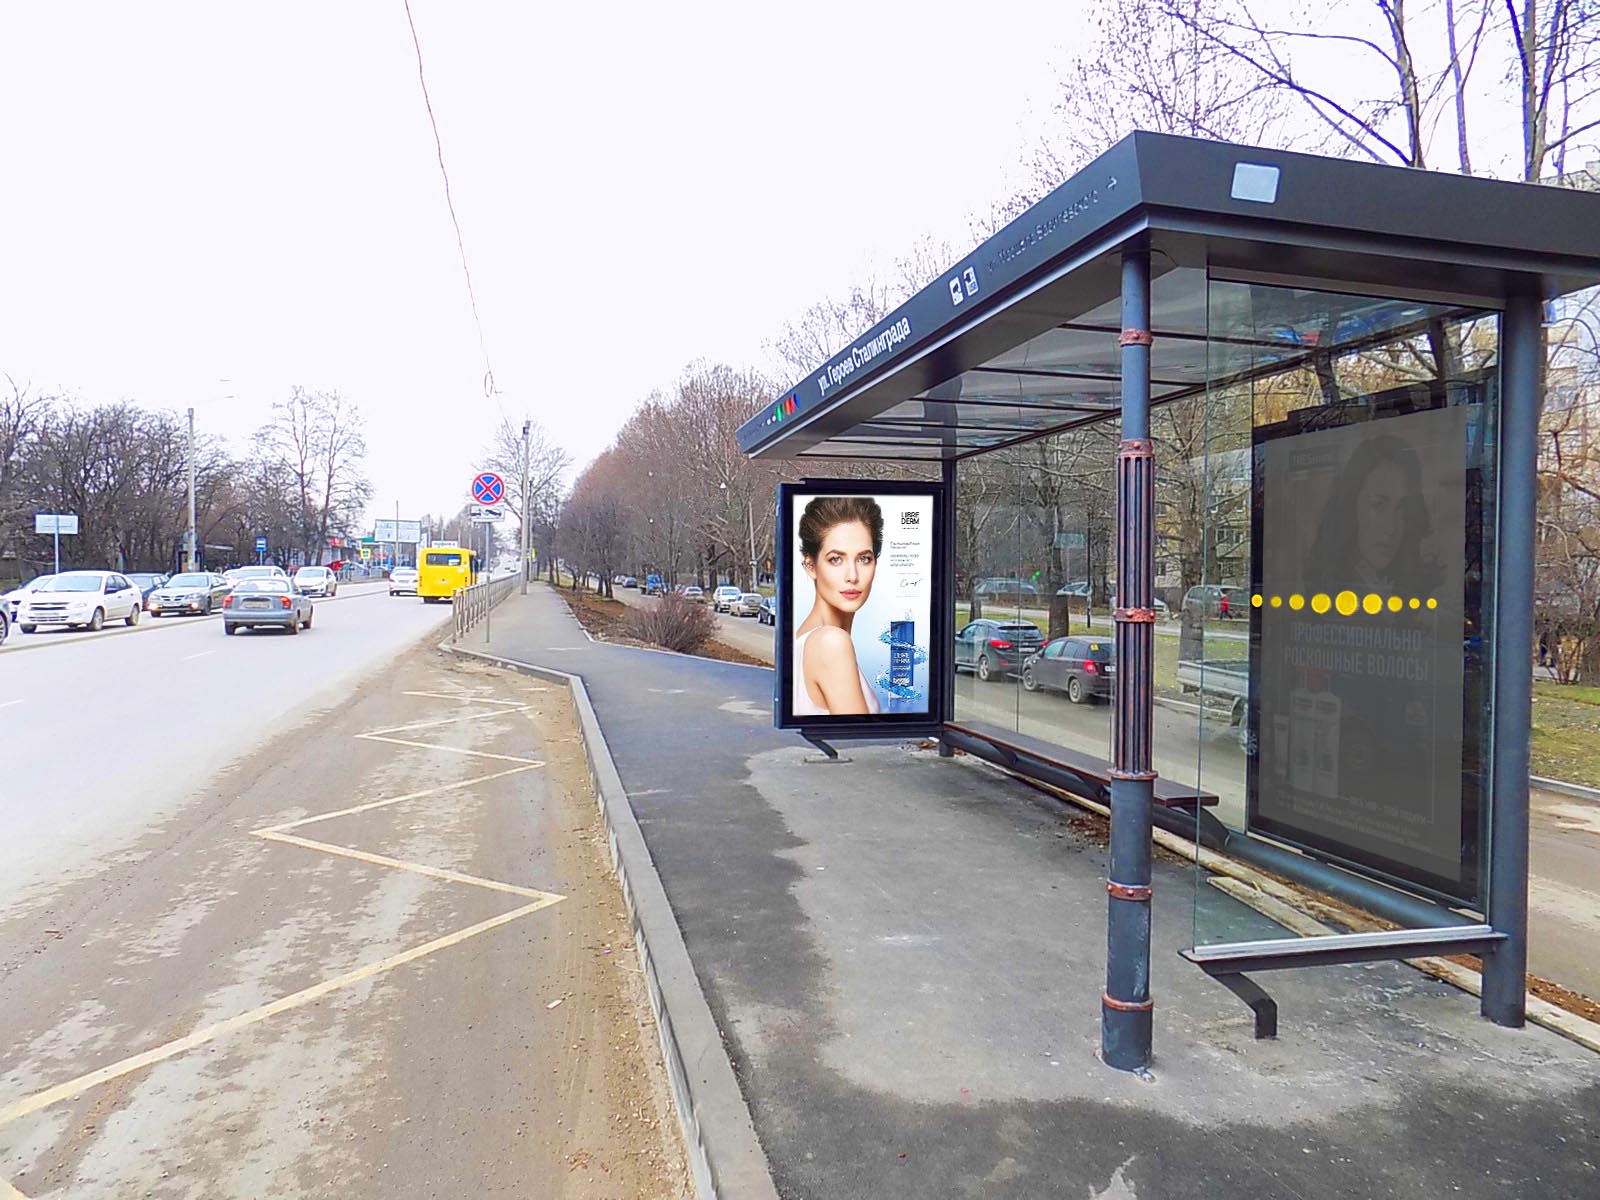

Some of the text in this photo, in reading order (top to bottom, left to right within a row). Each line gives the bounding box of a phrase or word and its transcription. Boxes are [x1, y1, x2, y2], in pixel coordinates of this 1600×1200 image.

[817, 317, 911, 396] ул. Героев Сталинграда
[1290, 621, 1422, 653] ПРОФЕССИОНАЛЬНО
[1284, 646, 1429, 681] РОСКОШНЫЕ ВОЛОСЫ
